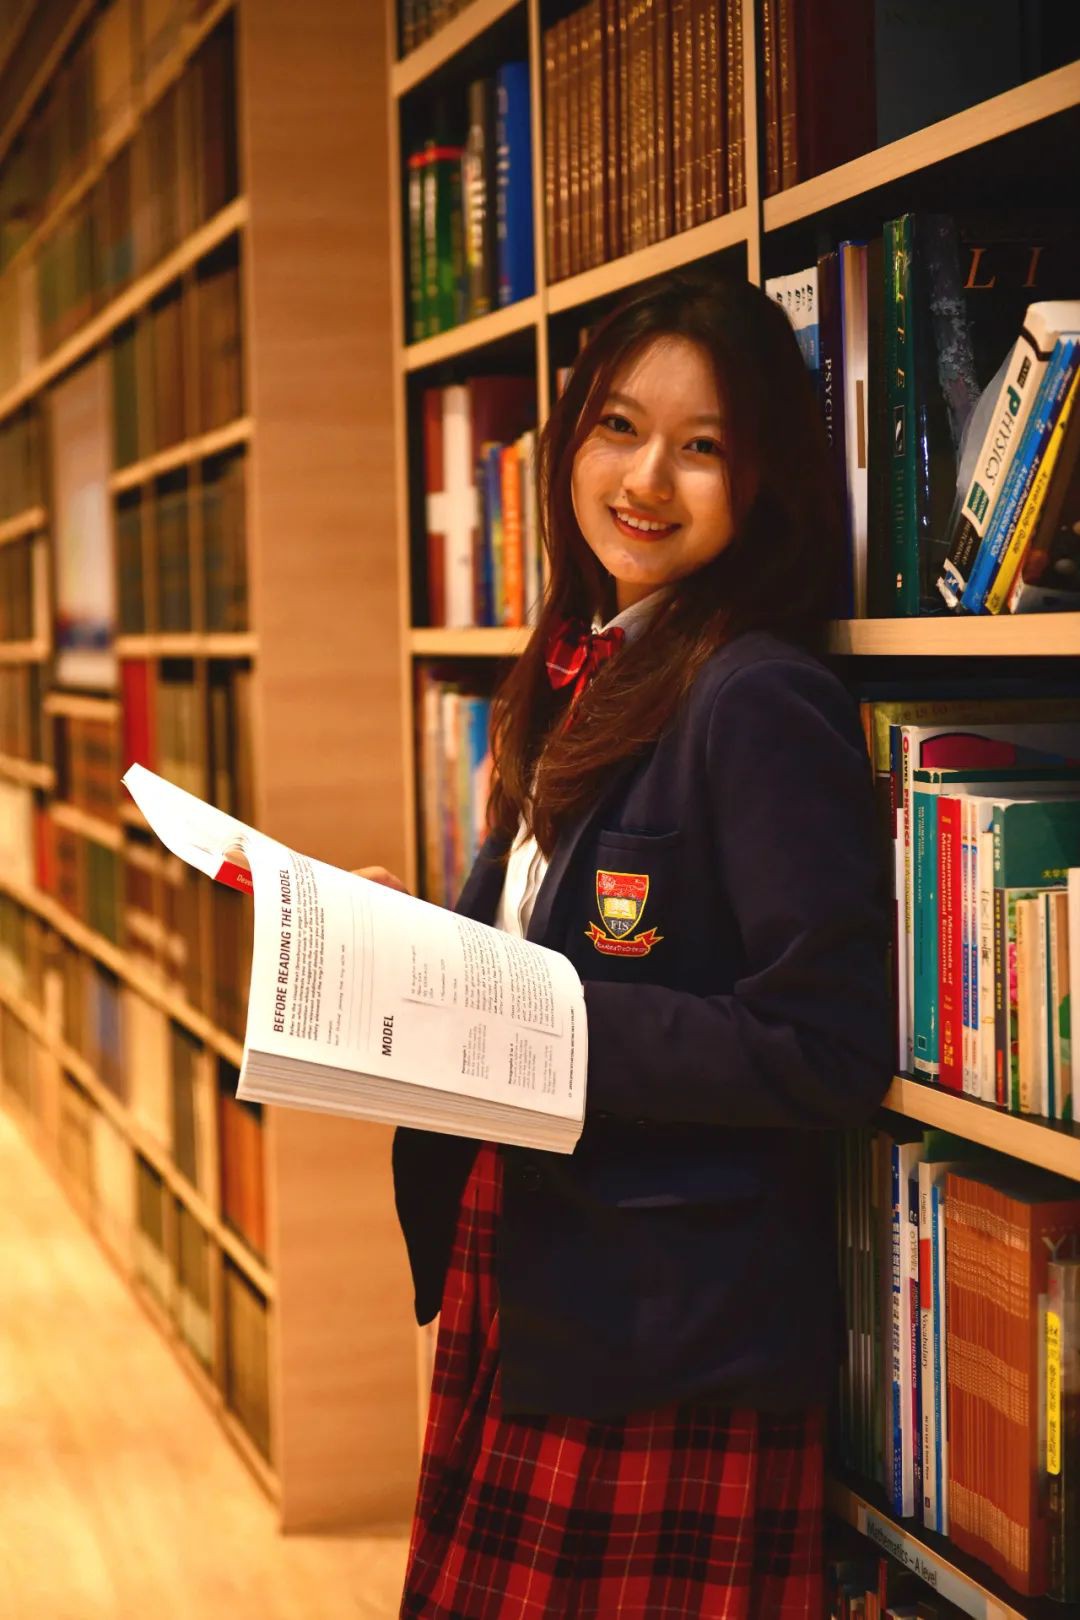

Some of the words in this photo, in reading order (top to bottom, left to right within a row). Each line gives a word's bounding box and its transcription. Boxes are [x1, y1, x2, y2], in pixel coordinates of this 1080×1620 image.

[986, 385, 1021, 486] PHYSICS
[280, 869, 290, 898] MODEL
[281, 902, 292, 928] THE
[610, 920, 629, 930] FIS
[278, 932, 292, 986] READING
[948, 972, 953, 984] of
[273, 990, 286, 1032] BEFORE
[382, 1014, 394, 1056] MODEL
